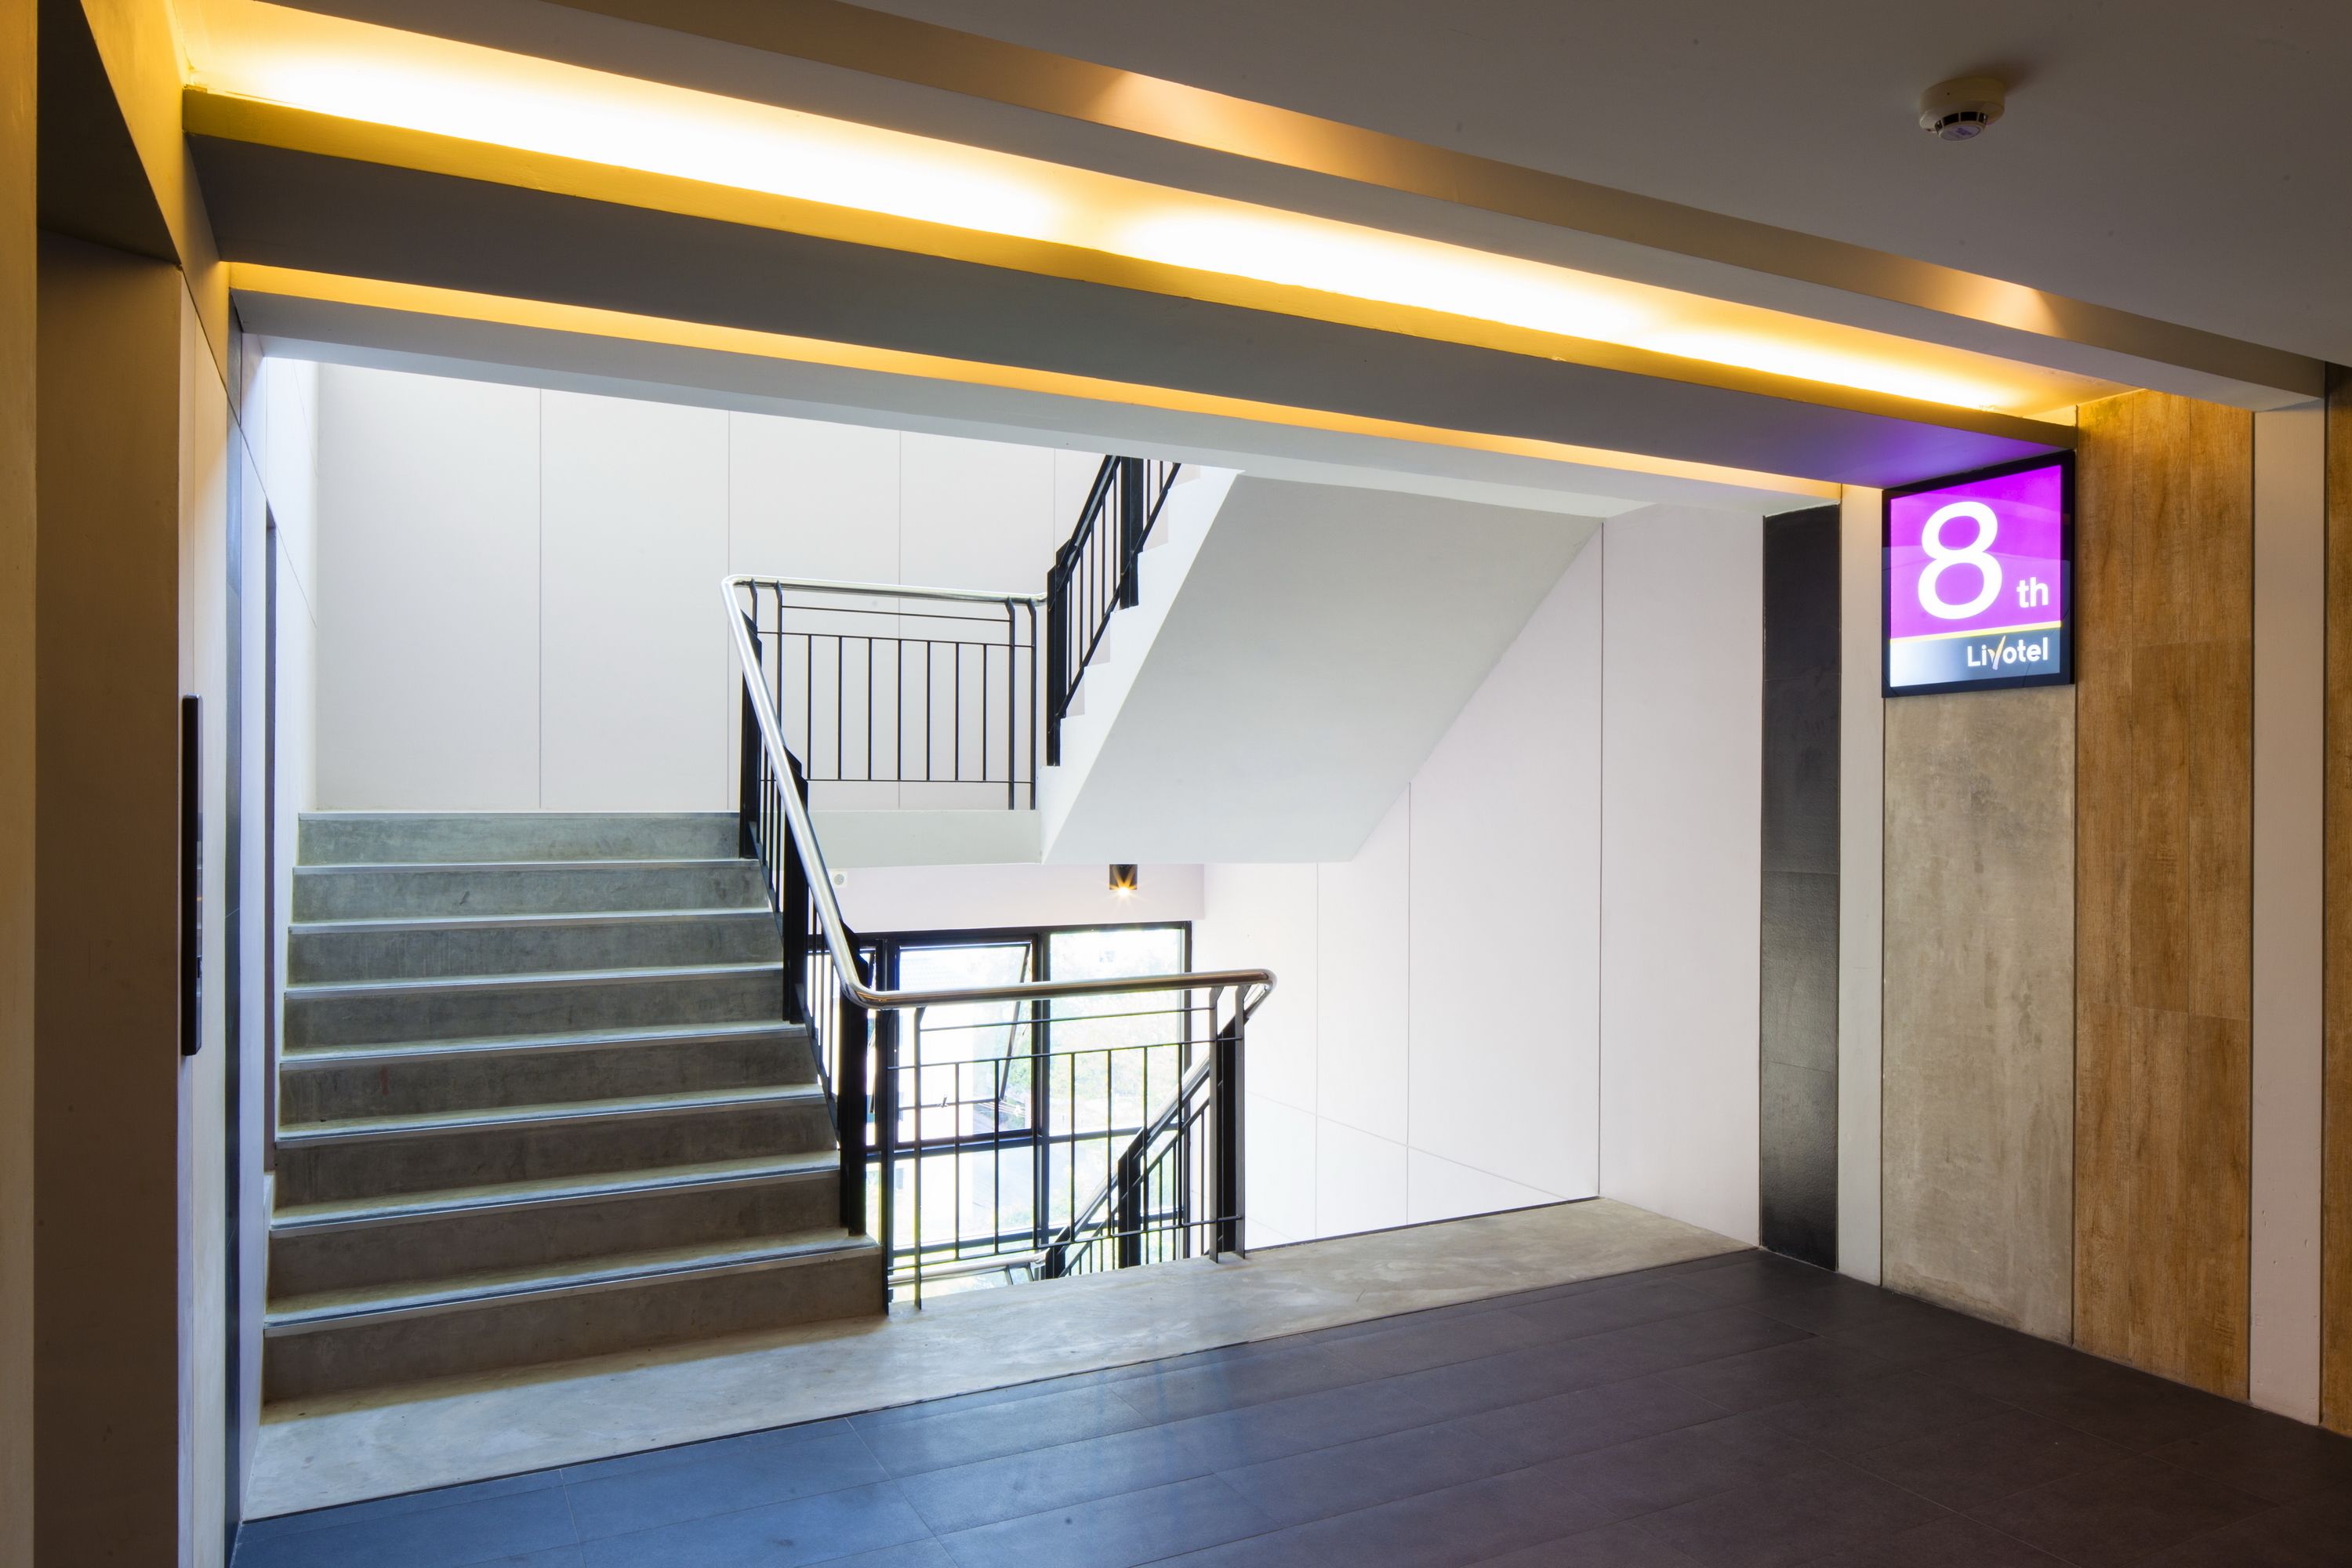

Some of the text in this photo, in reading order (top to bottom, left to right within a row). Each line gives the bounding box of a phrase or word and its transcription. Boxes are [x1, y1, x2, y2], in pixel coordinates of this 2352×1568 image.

[1918, 501, 2049, 619] 8 th
[1966, 635, 2049, 670] Livotel
